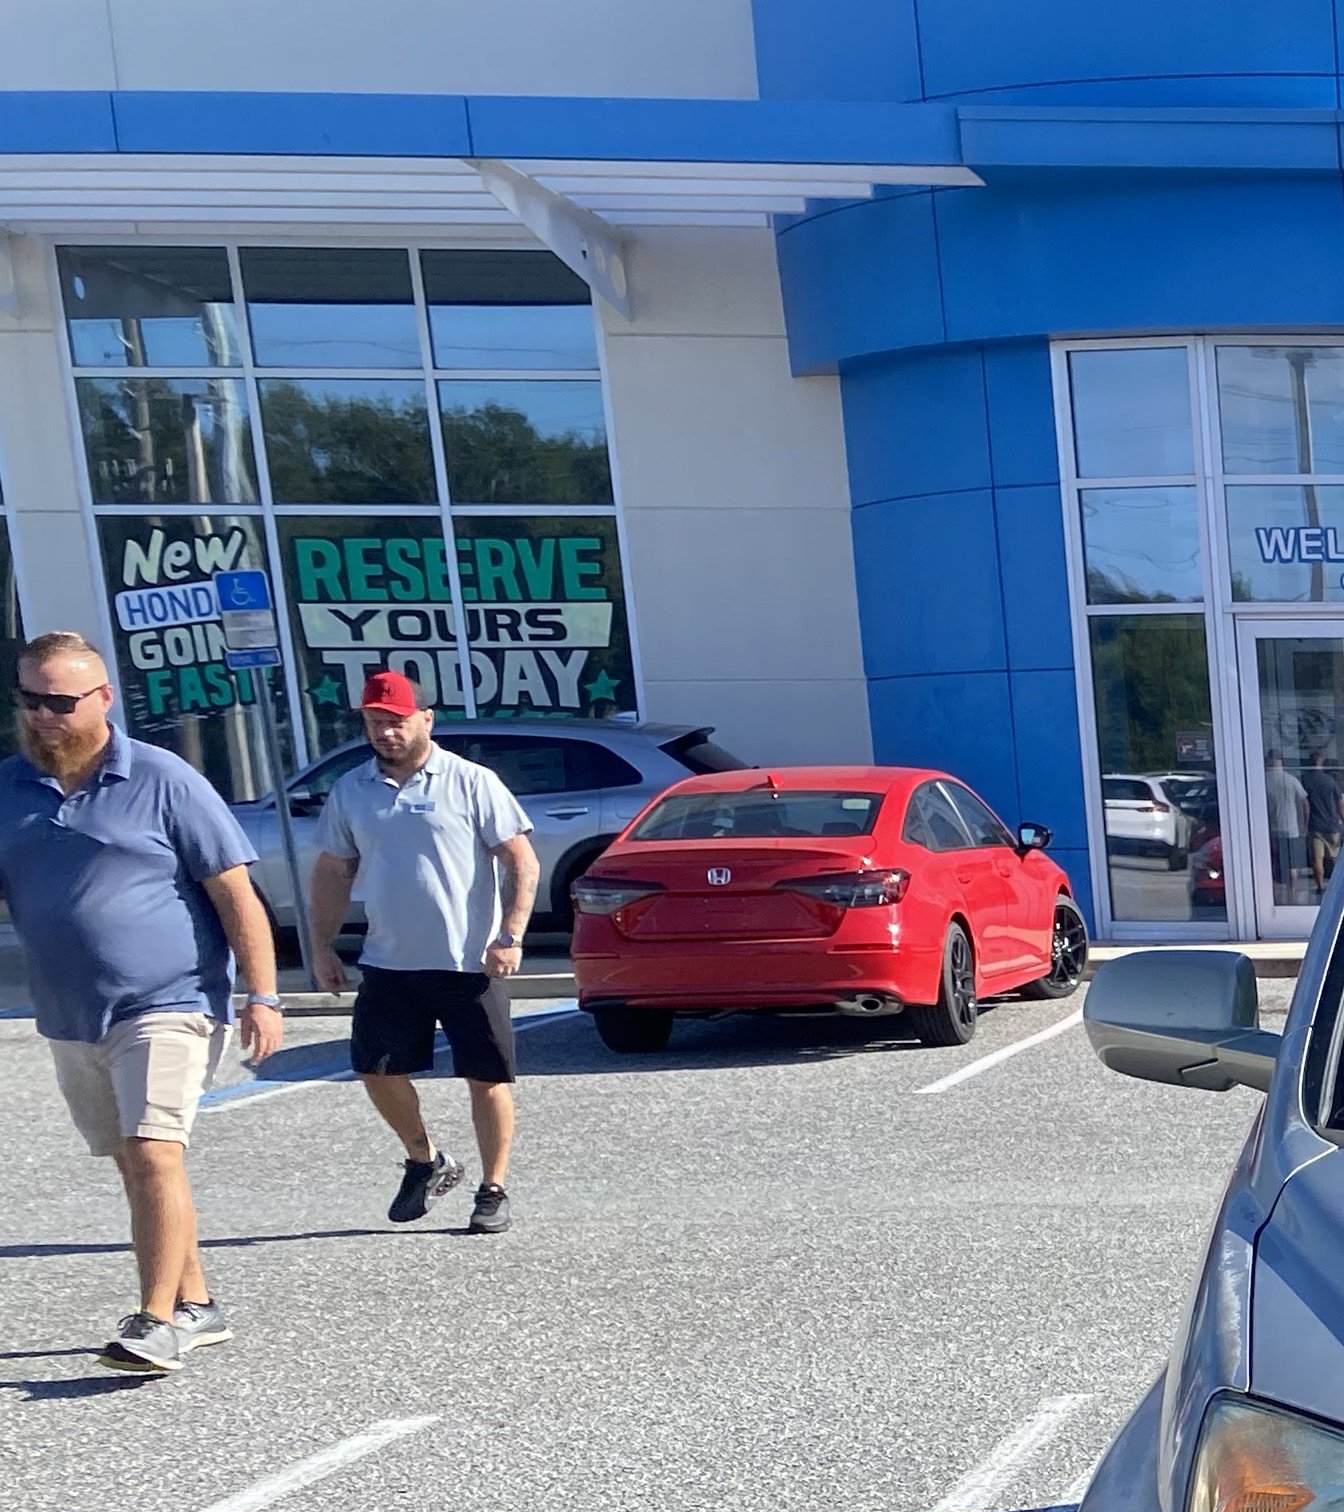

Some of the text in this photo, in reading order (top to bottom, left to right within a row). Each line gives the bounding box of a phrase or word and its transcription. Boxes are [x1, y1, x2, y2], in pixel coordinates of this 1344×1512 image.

[122, 528, 243, 587] New
[293, 537, 608, 601] RESERVE
[124, 586, 214, 627] HOND
[327, 607, 568, 642] YOURS
[128, 622, 226, 670] GOIN
[147, 663, 254, 715] FAST
[321, 650, 590, 710] TODAY
